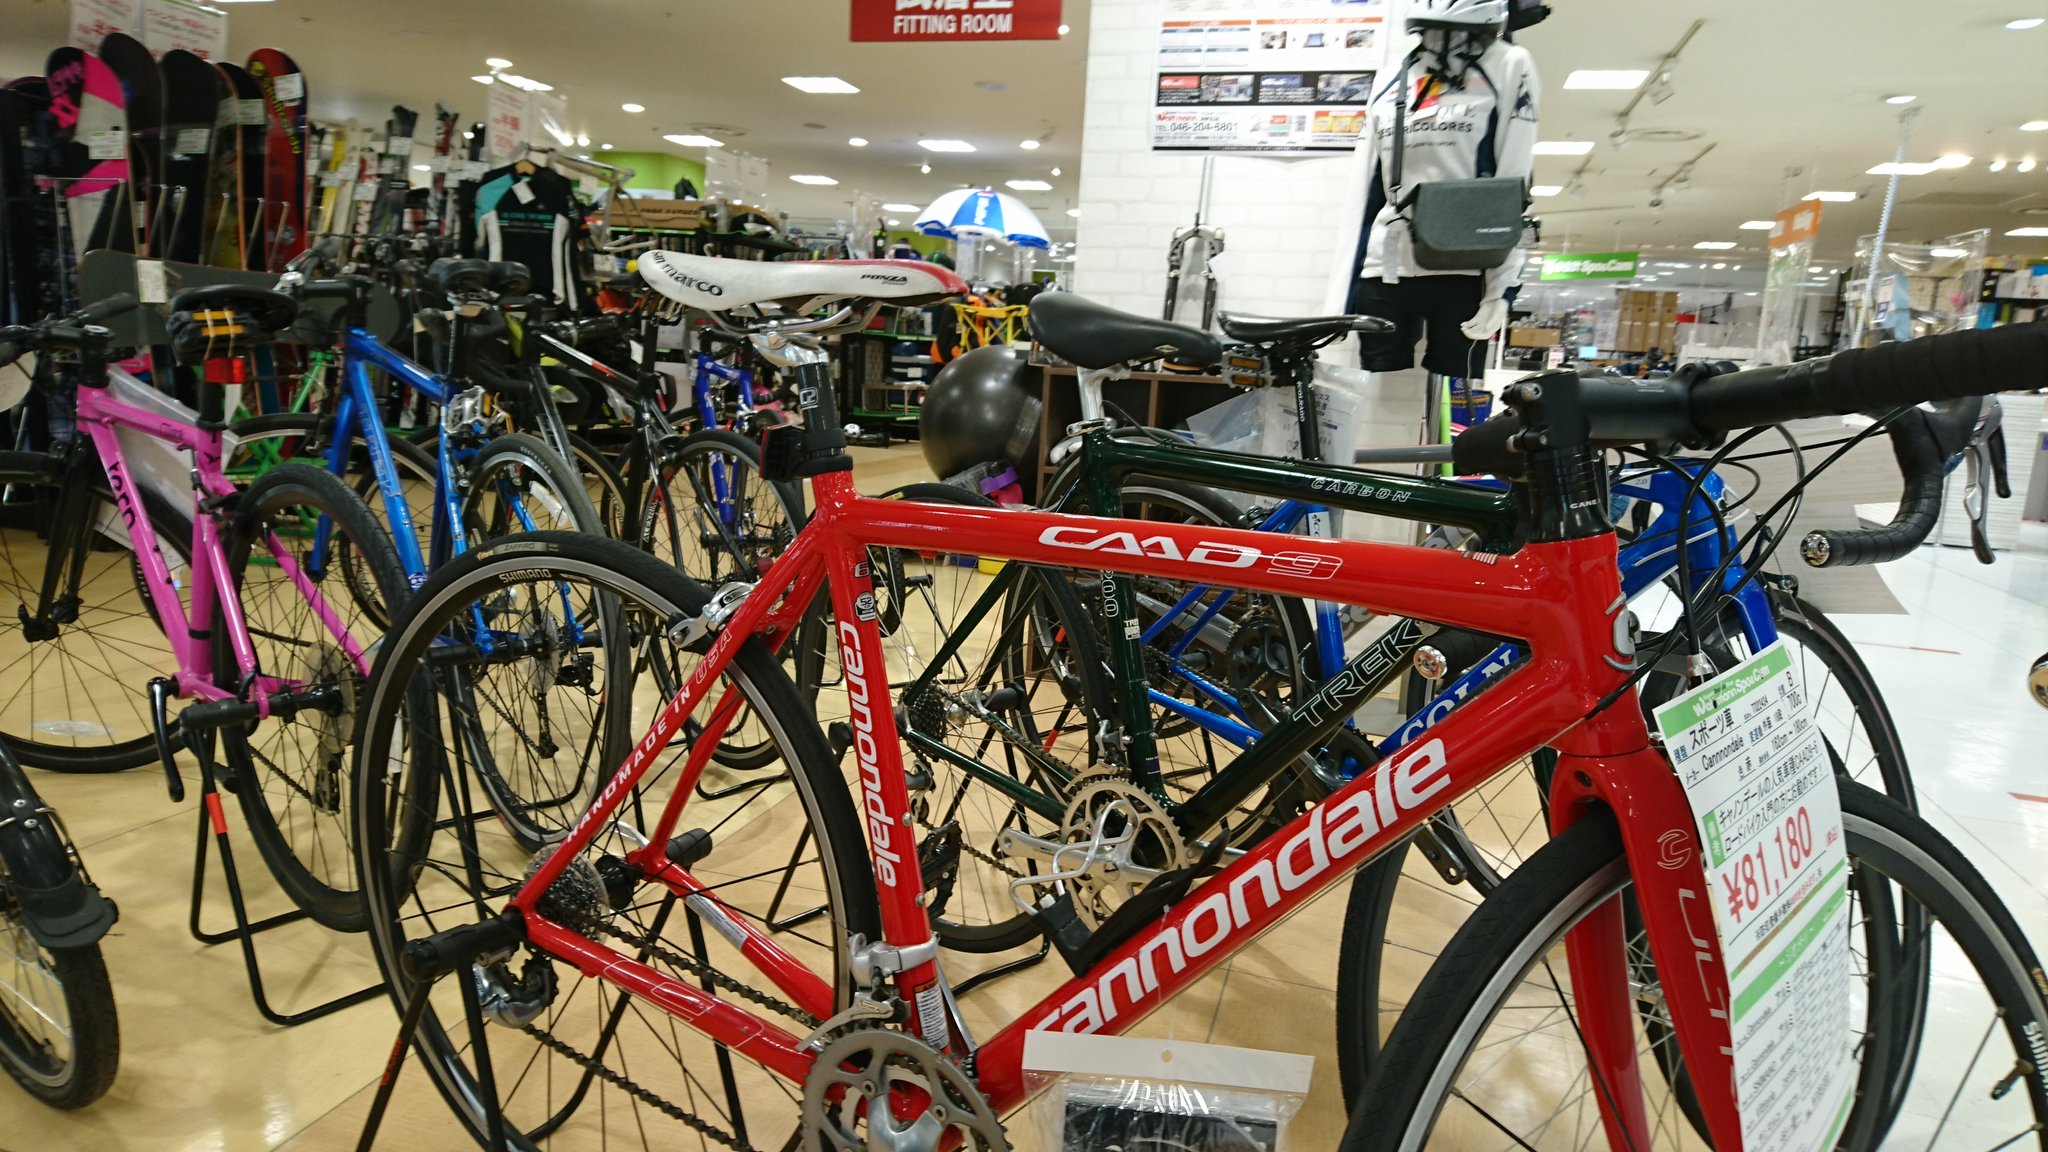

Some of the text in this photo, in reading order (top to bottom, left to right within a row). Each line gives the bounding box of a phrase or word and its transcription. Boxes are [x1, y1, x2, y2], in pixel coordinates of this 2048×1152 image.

[893, 13, 1013, 34] FITTING ROOM
[1311, 476, 1411, 503] CARBON
[499, 568, 552, 583] SHIMANO
[1293, 618, 1424, 727] TREK
[566, 628, 733, 843] HANDMADE IN USA
[840, 621, 900, 887] cannondale
[1689, 707, 1735, 751] スポーツ車
[1722, 805, 1812, 924] ¥81,180
